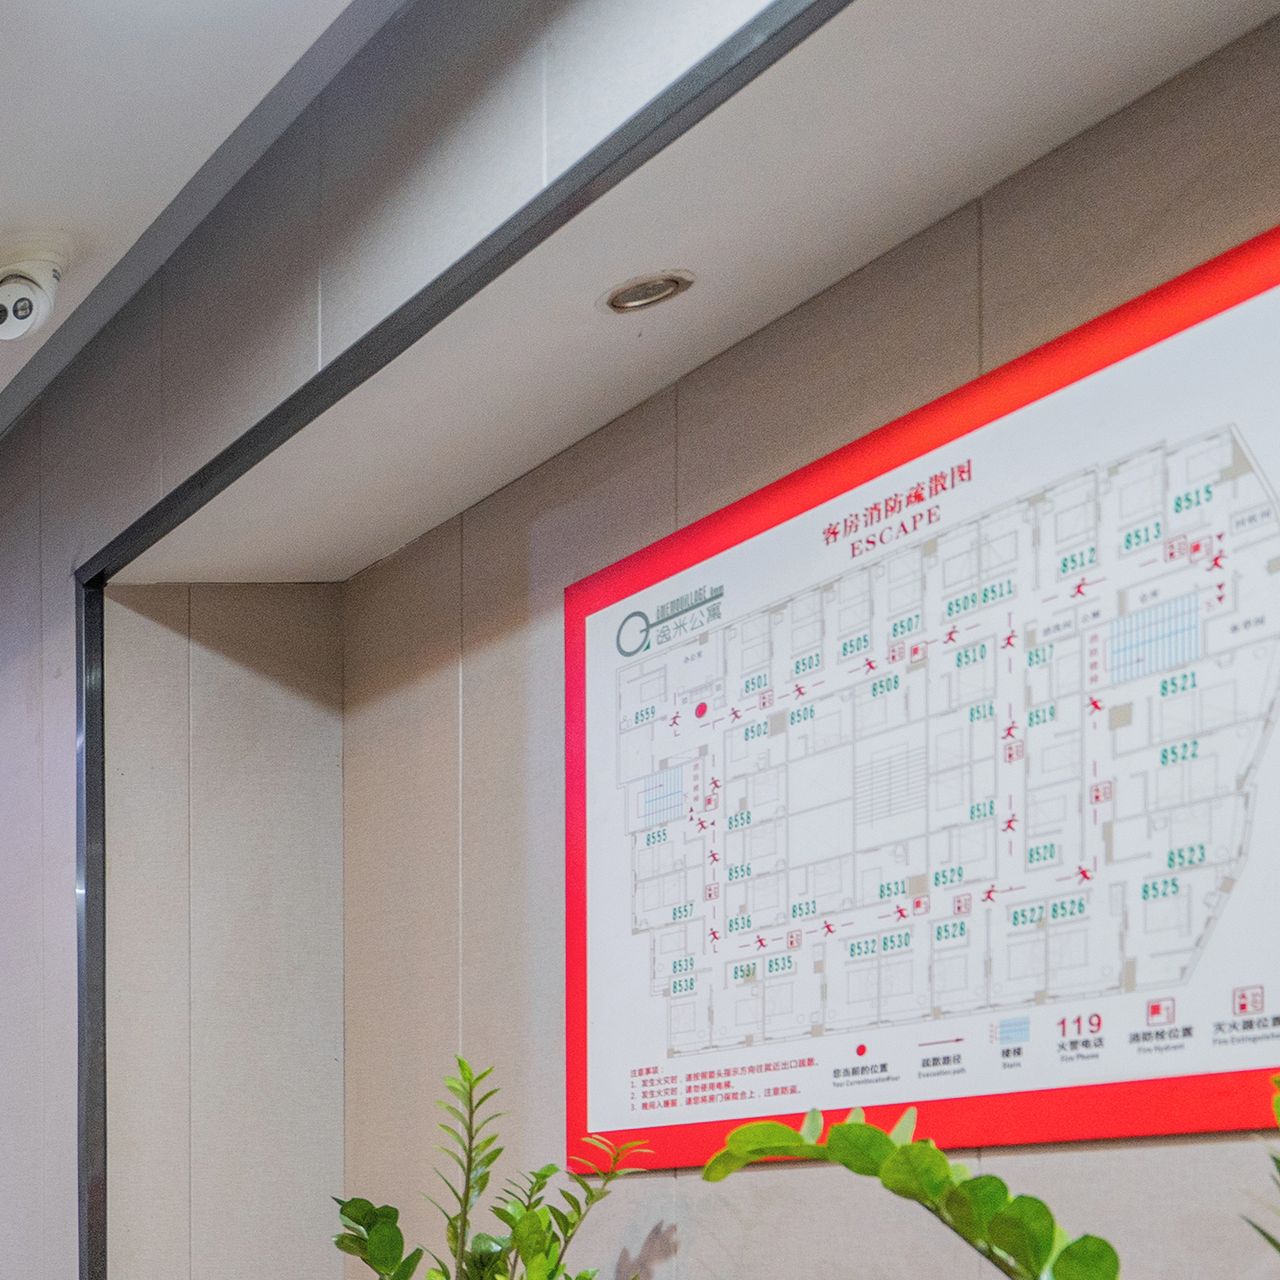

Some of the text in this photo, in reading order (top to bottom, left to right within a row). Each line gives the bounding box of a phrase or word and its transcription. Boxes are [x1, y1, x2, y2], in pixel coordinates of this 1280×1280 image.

[822, 459, 972, 545] 客房消防疏散图
[1174, 484, 1212, 513] 8515
[850, 505, 940, 558] ESCAPE
[1124, 522, 1161, 549] 8513
[1061, 547, 1095, 573] 8512
[982, 579, 1012, 603] 8511
[947, 593, 977, 617] 8509
[892, 615, 920, 637] 8507
[843, 635, 869, 656] 8505
[956, 644, 986, 667] 8510
[795, 654, 820, 674] 8503
[745, 673, 768, 693] 8501
[872, 675, 899, 697] 8508
[1161, 672, 1196, 696] 8521
[635, 706, 656, 724] 8559
[790, 705, 815, 725] 8506
[744, 722, 768, 741] 8502
[1161, 740, 1198, 766] 8522
[728, 811, 751, 830] 8558
[646, 829, 667, 846] 8555
[1029, 844, 1055, 863] 8520
[1168, 844, 1205, 868] 8523
[934, 867, 963, 886] 8529
[880, 881, 906, 898] 8531
[1142, 878, 1179, 900] 8525
[673, 904, 693, 920] 8557
[792, 900, 816, 918] 8533
[1013, 906, 1044, 926] 8527
[1052, 898, 1084, 919] 8526
[882, 932, 910, 951] 8530
[937, 922, 965, 941] 8528
[850, 939, 877, 957] 8532
[673, 958, 694, 973] 8539
[768, 956, 792, 973] 8535
[673, 978, 694, 993] 8538
[1057, 1013, 1102, 1037] 119
